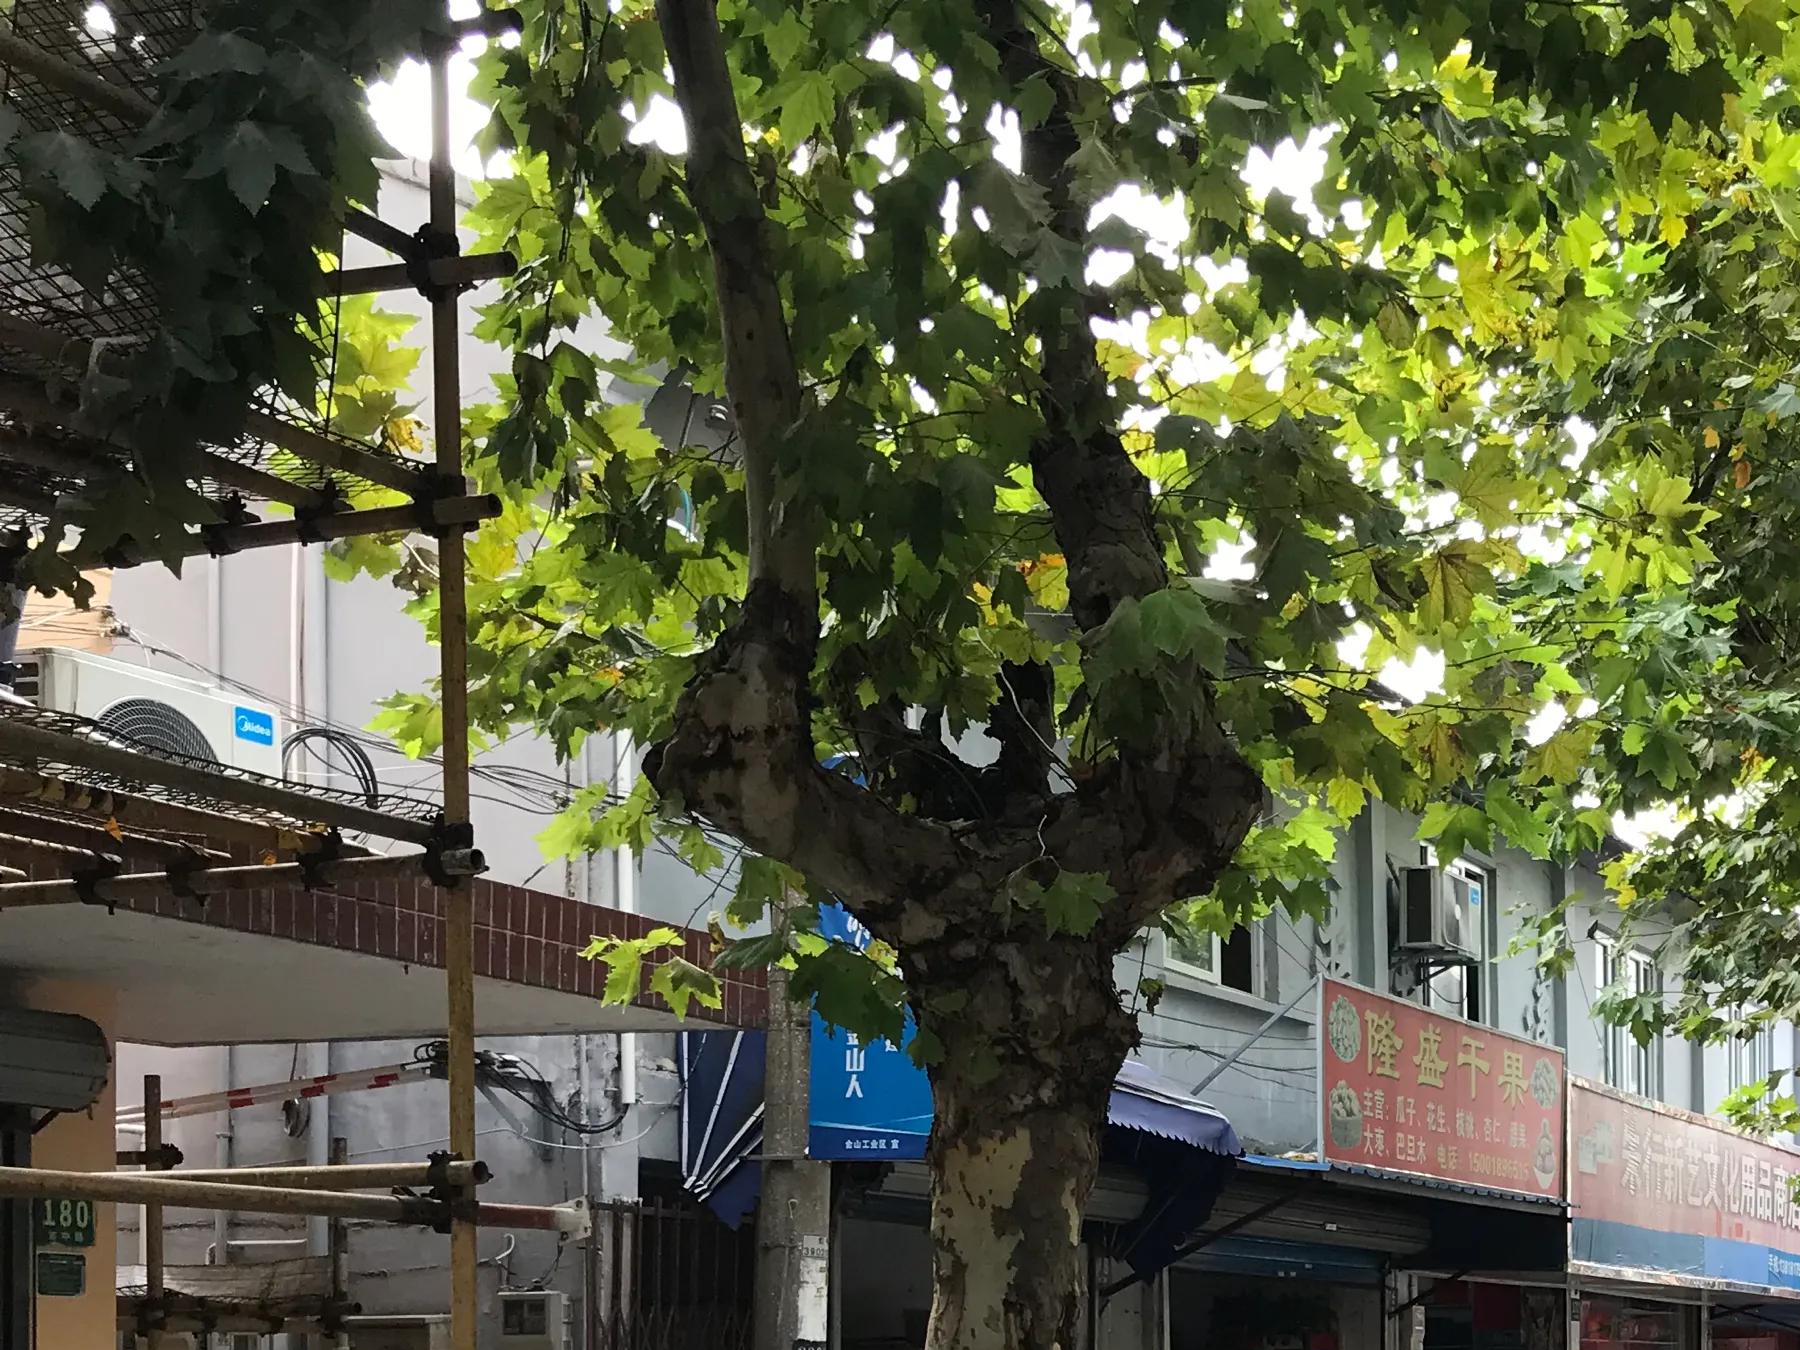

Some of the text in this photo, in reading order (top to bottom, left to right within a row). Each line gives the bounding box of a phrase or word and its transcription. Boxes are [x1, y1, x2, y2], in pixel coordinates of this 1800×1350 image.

[1364, 1009, 1529, 1109] 隆盛干果
[42, 1199, 89, 1228] 180
